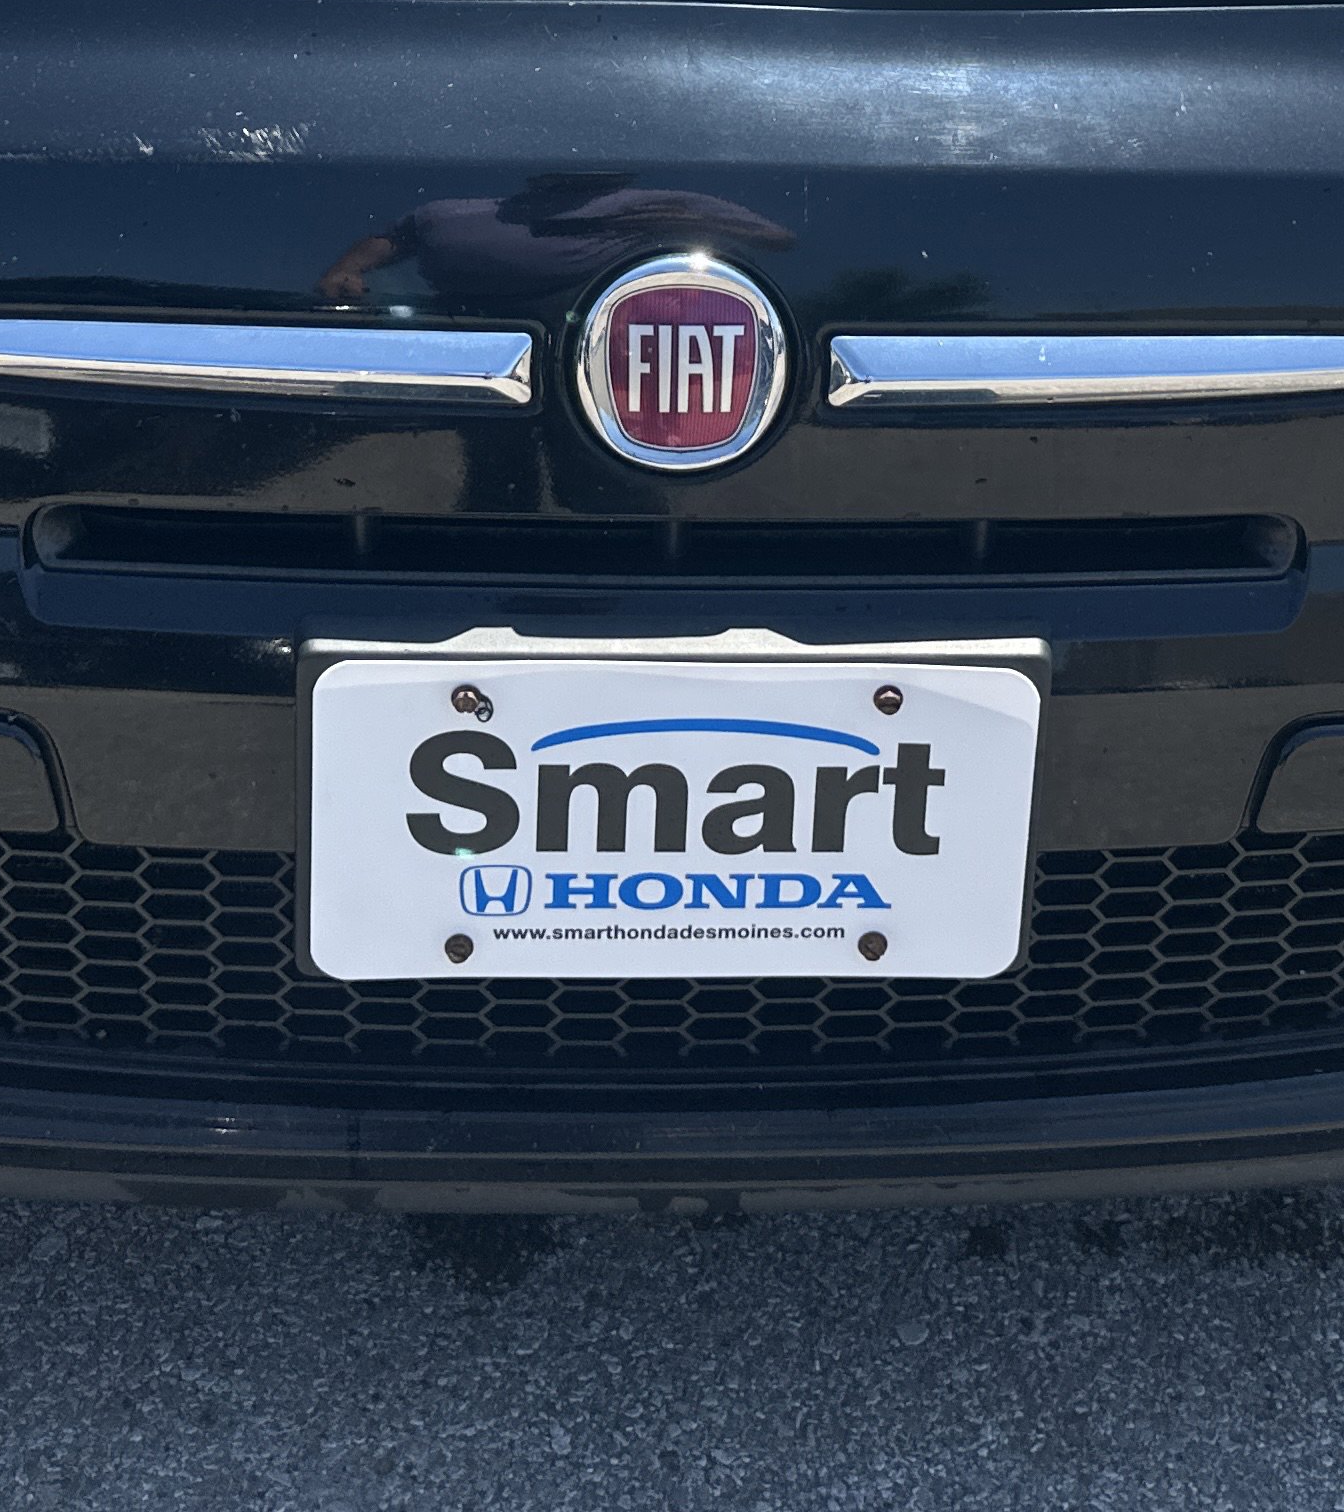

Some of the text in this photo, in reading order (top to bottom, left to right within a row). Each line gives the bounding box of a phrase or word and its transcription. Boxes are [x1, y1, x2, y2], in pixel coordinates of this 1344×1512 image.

[628, 323, 746, 414] FIAT
[405, 728, 946, 856] Smart
[543, 872, 892, 910] HONDA
[493, 923, 846, 941] www.smarthondadesmoines.com
